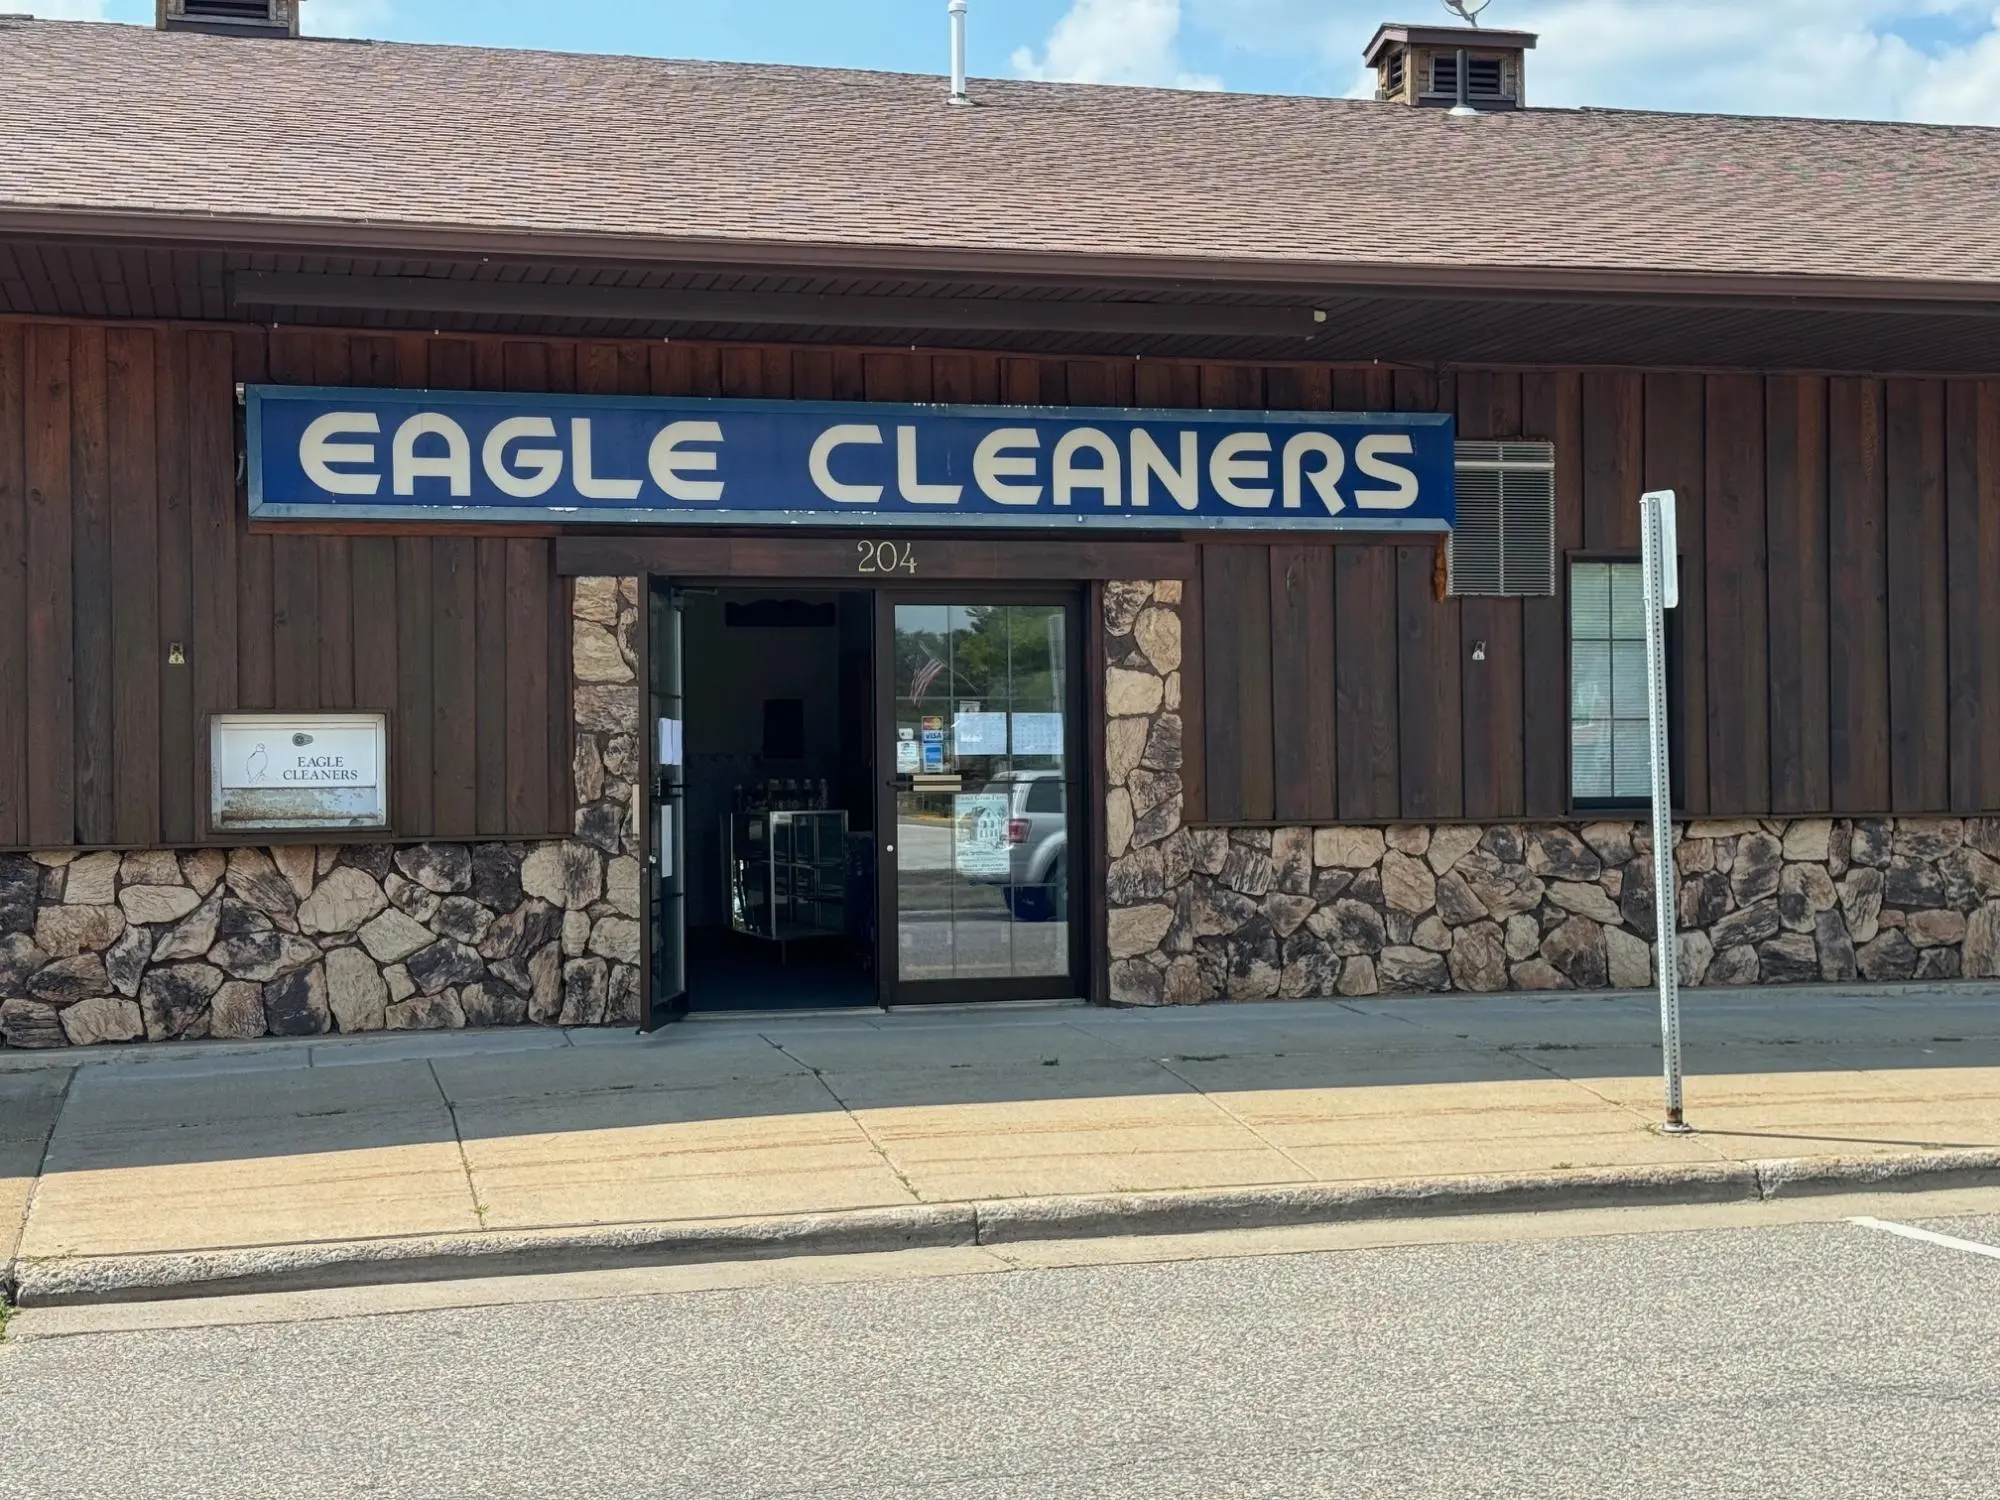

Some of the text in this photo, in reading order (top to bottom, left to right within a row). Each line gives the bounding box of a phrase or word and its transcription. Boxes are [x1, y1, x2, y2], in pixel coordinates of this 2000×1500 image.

[300, 411, 1420, 516] EAGLE CLEANERS
[857, 540, 918, 573] 204
[297, 756, 344, 768] EAGLE
[282, 769, 359, 781] CLEANERS
